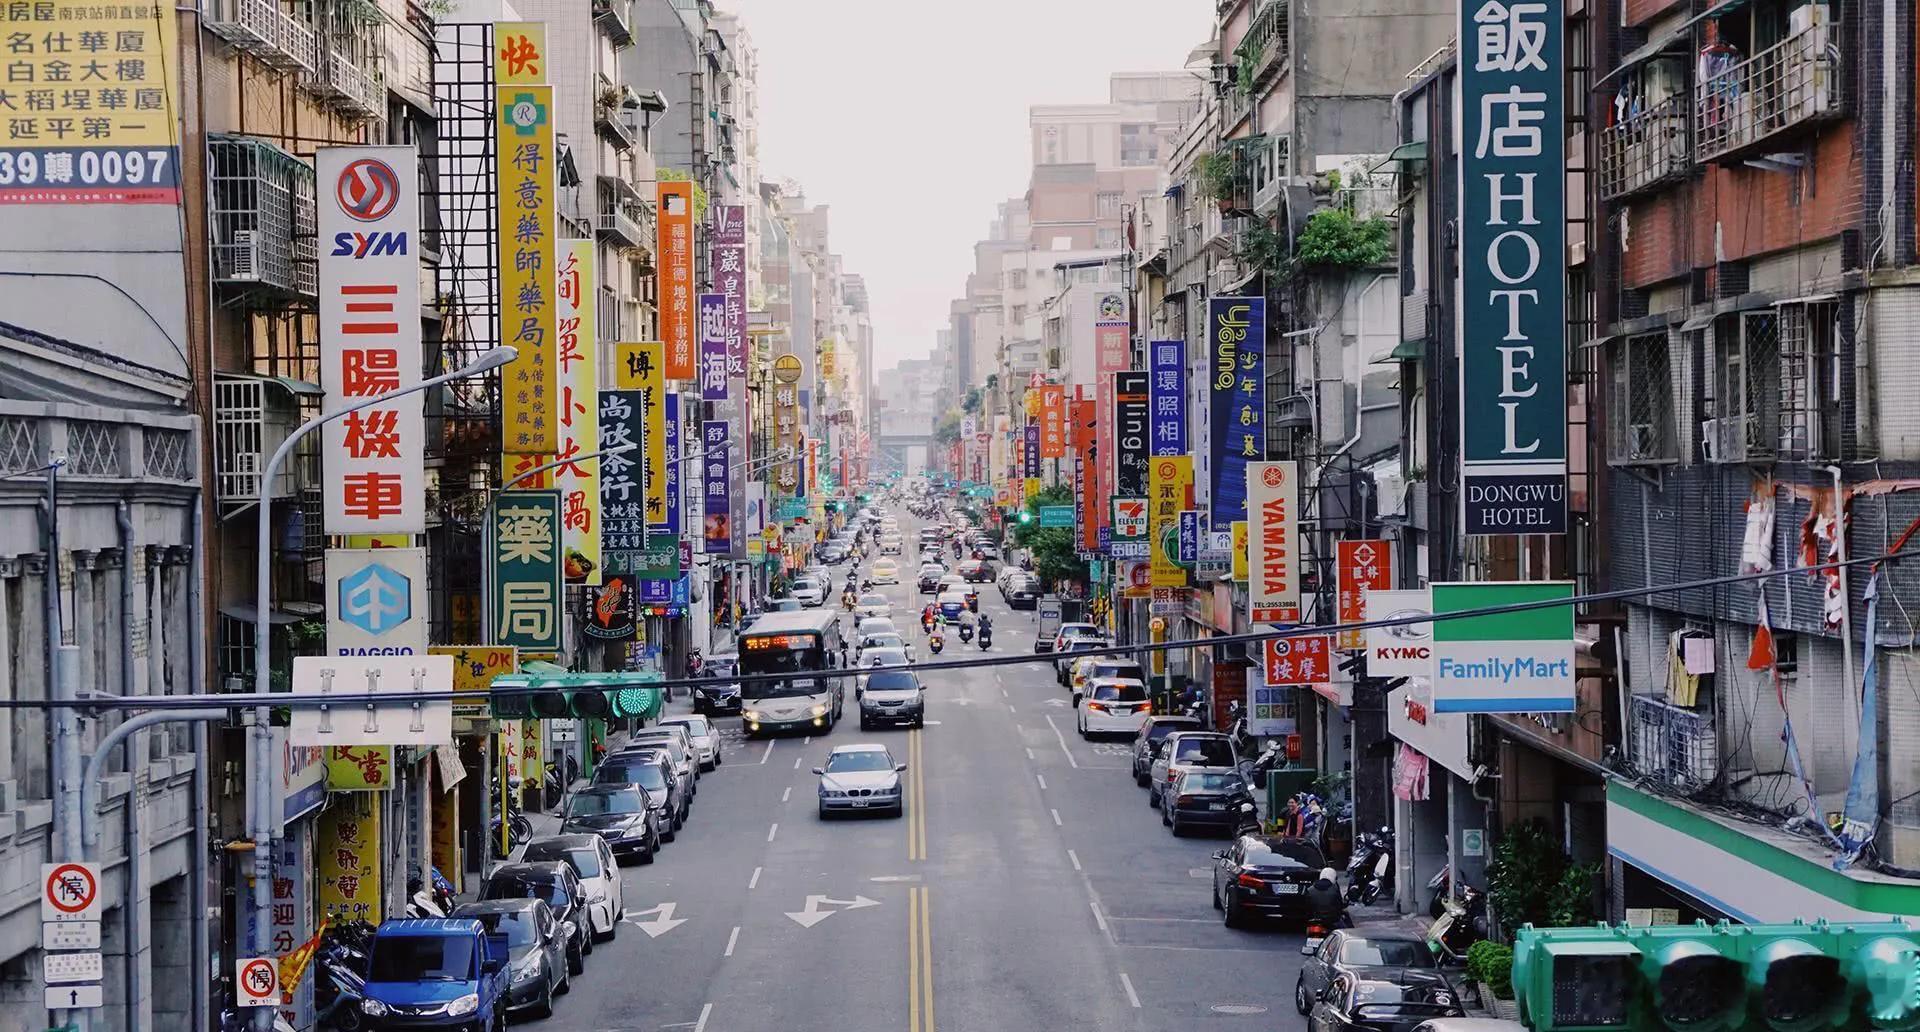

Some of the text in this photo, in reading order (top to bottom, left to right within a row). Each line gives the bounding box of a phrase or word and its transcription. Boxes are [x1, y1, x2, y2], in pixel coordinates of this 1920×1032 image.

[0, 1, 55, 21] 房屋
[6, 30, 145, 53] 名仕華廈
[500, 35, 540, 77] 快
[8, 59, 145, 82] 白金大樓
[1473, 0, 1548, 159] 飯店
[0, 88, 165, 111] 大稻埕華廈
[8, 117, 146, 139] 延平第一
[0, 151, 38, 184] 39
[79, 150, 168, 184] 0097
[330, 231, 408, 259] SYM
[512, 143, 545, 347] 得意藥師藥局
[1483, 172, 1541, 454] HOTEL
[702, 303, 728, 392] 越海
[340, 284, 402, 520] 三陽機車
[599, 395, 638, 501] 尚欣茶行
[1469, 484, 1564, 503] DONGWU
[1481, 507, 1552, 526] HOTEL
[1263, 497, 1287, 596] YAMAHA
[498, 504, 554, 641] 藥局
[1272, 657, 1316, 681] 按摩
[1439, 657, 1569, 684] FamilyMart
[522, 725, 538, 761] 火鍋
[58, 876, 84, 901] 停
[250, 968, 270, 990] 停
